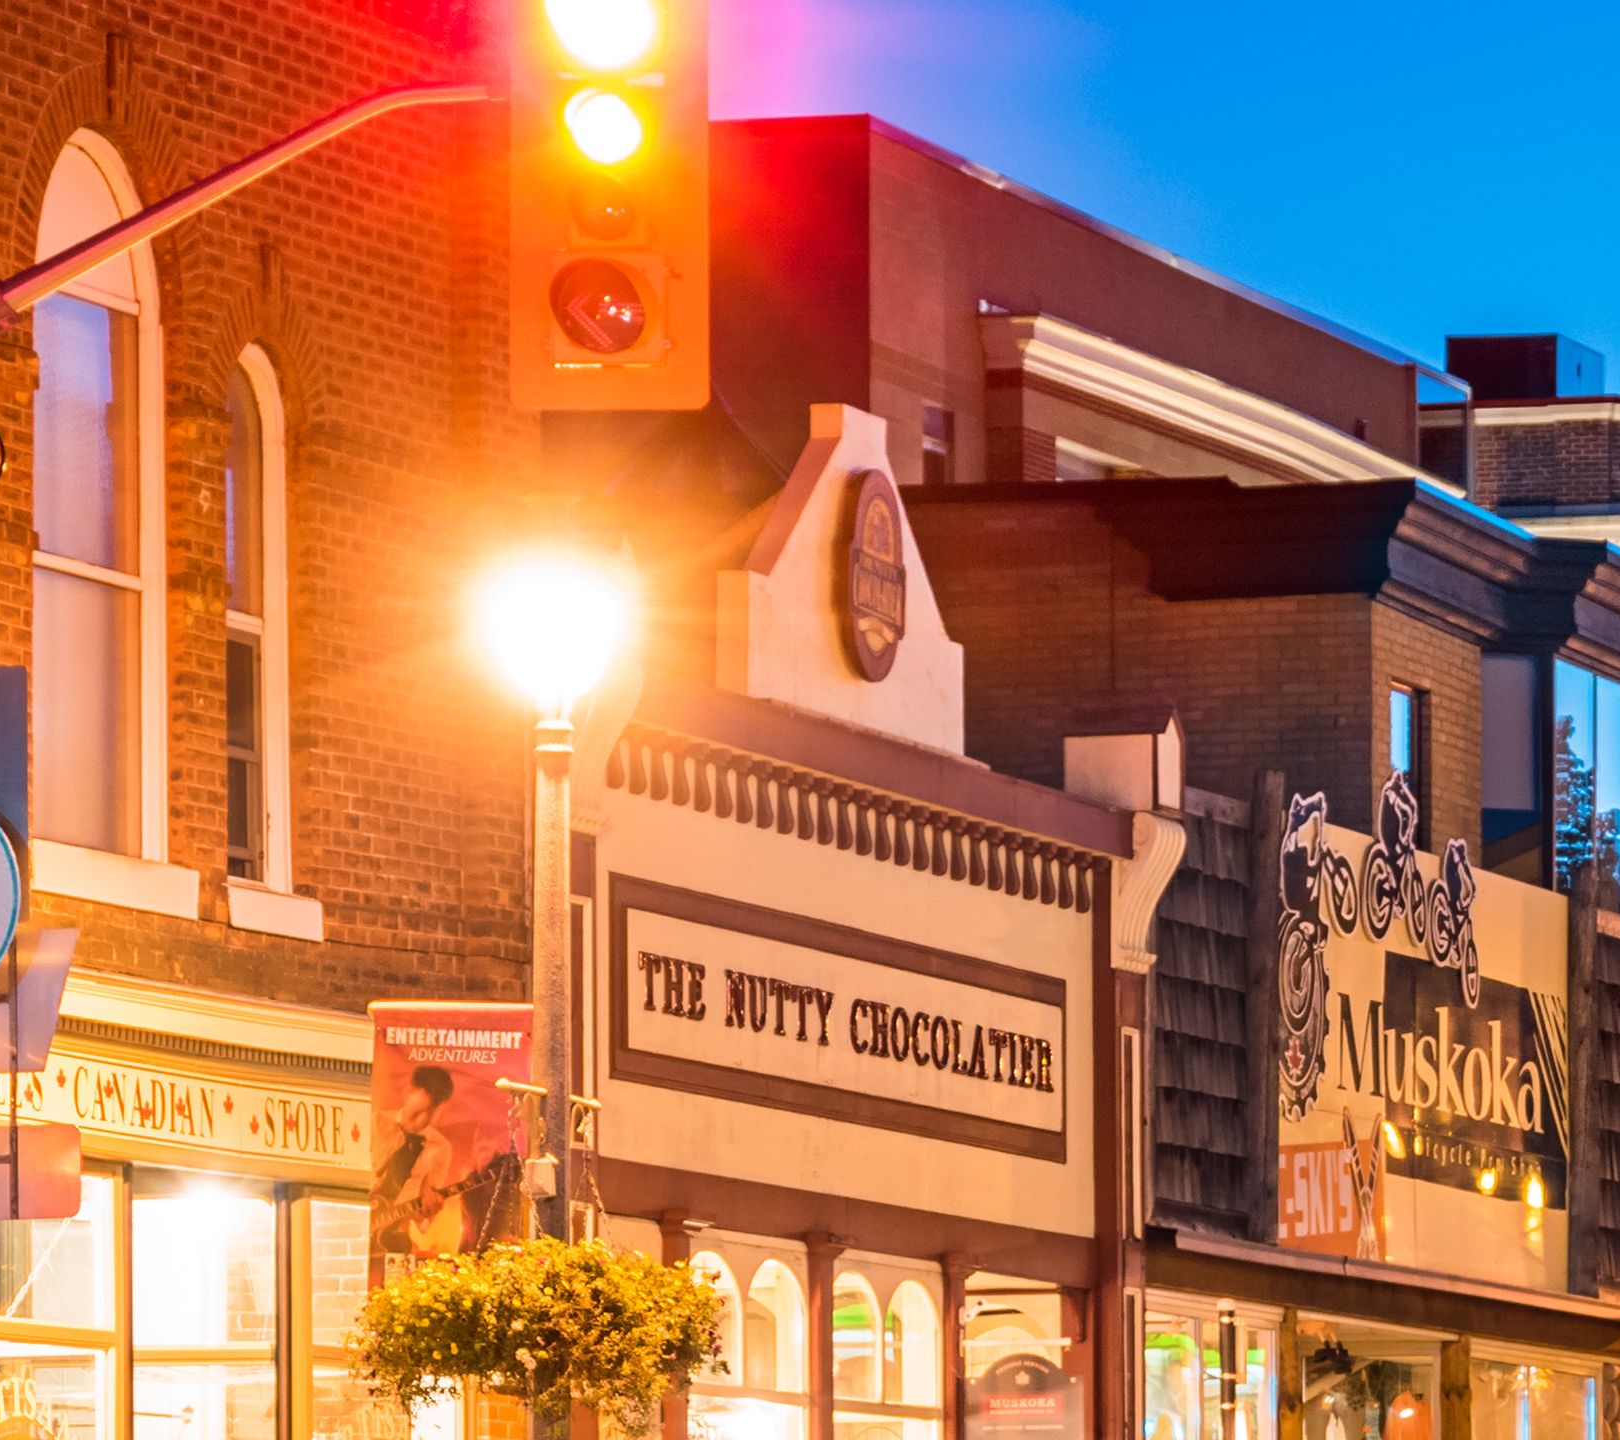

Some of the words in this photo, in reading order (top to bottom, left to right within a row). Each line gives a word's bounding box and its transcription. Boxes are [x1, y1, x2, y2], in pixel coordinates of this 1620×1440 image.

[638, 951, 707, 1021] THE
[724, 968, 835, 1046] NUTTY
[849, 998, 1055, 1093] CHOCOLATIER
[385, 1026, 523, 1050] ENTERTAINMENT
[408, 1048, 498, 1065] ADVENTURES
[1336, 992, 1545, 1135] Muskoka
[73, 1066, 215, 1138] CANADIAN
[264, 1095, 345, 1155] STORE
[1423, 1138, 1472, 1168] icycle
[989, 1397, 1056, 1408] MUSKOKA
